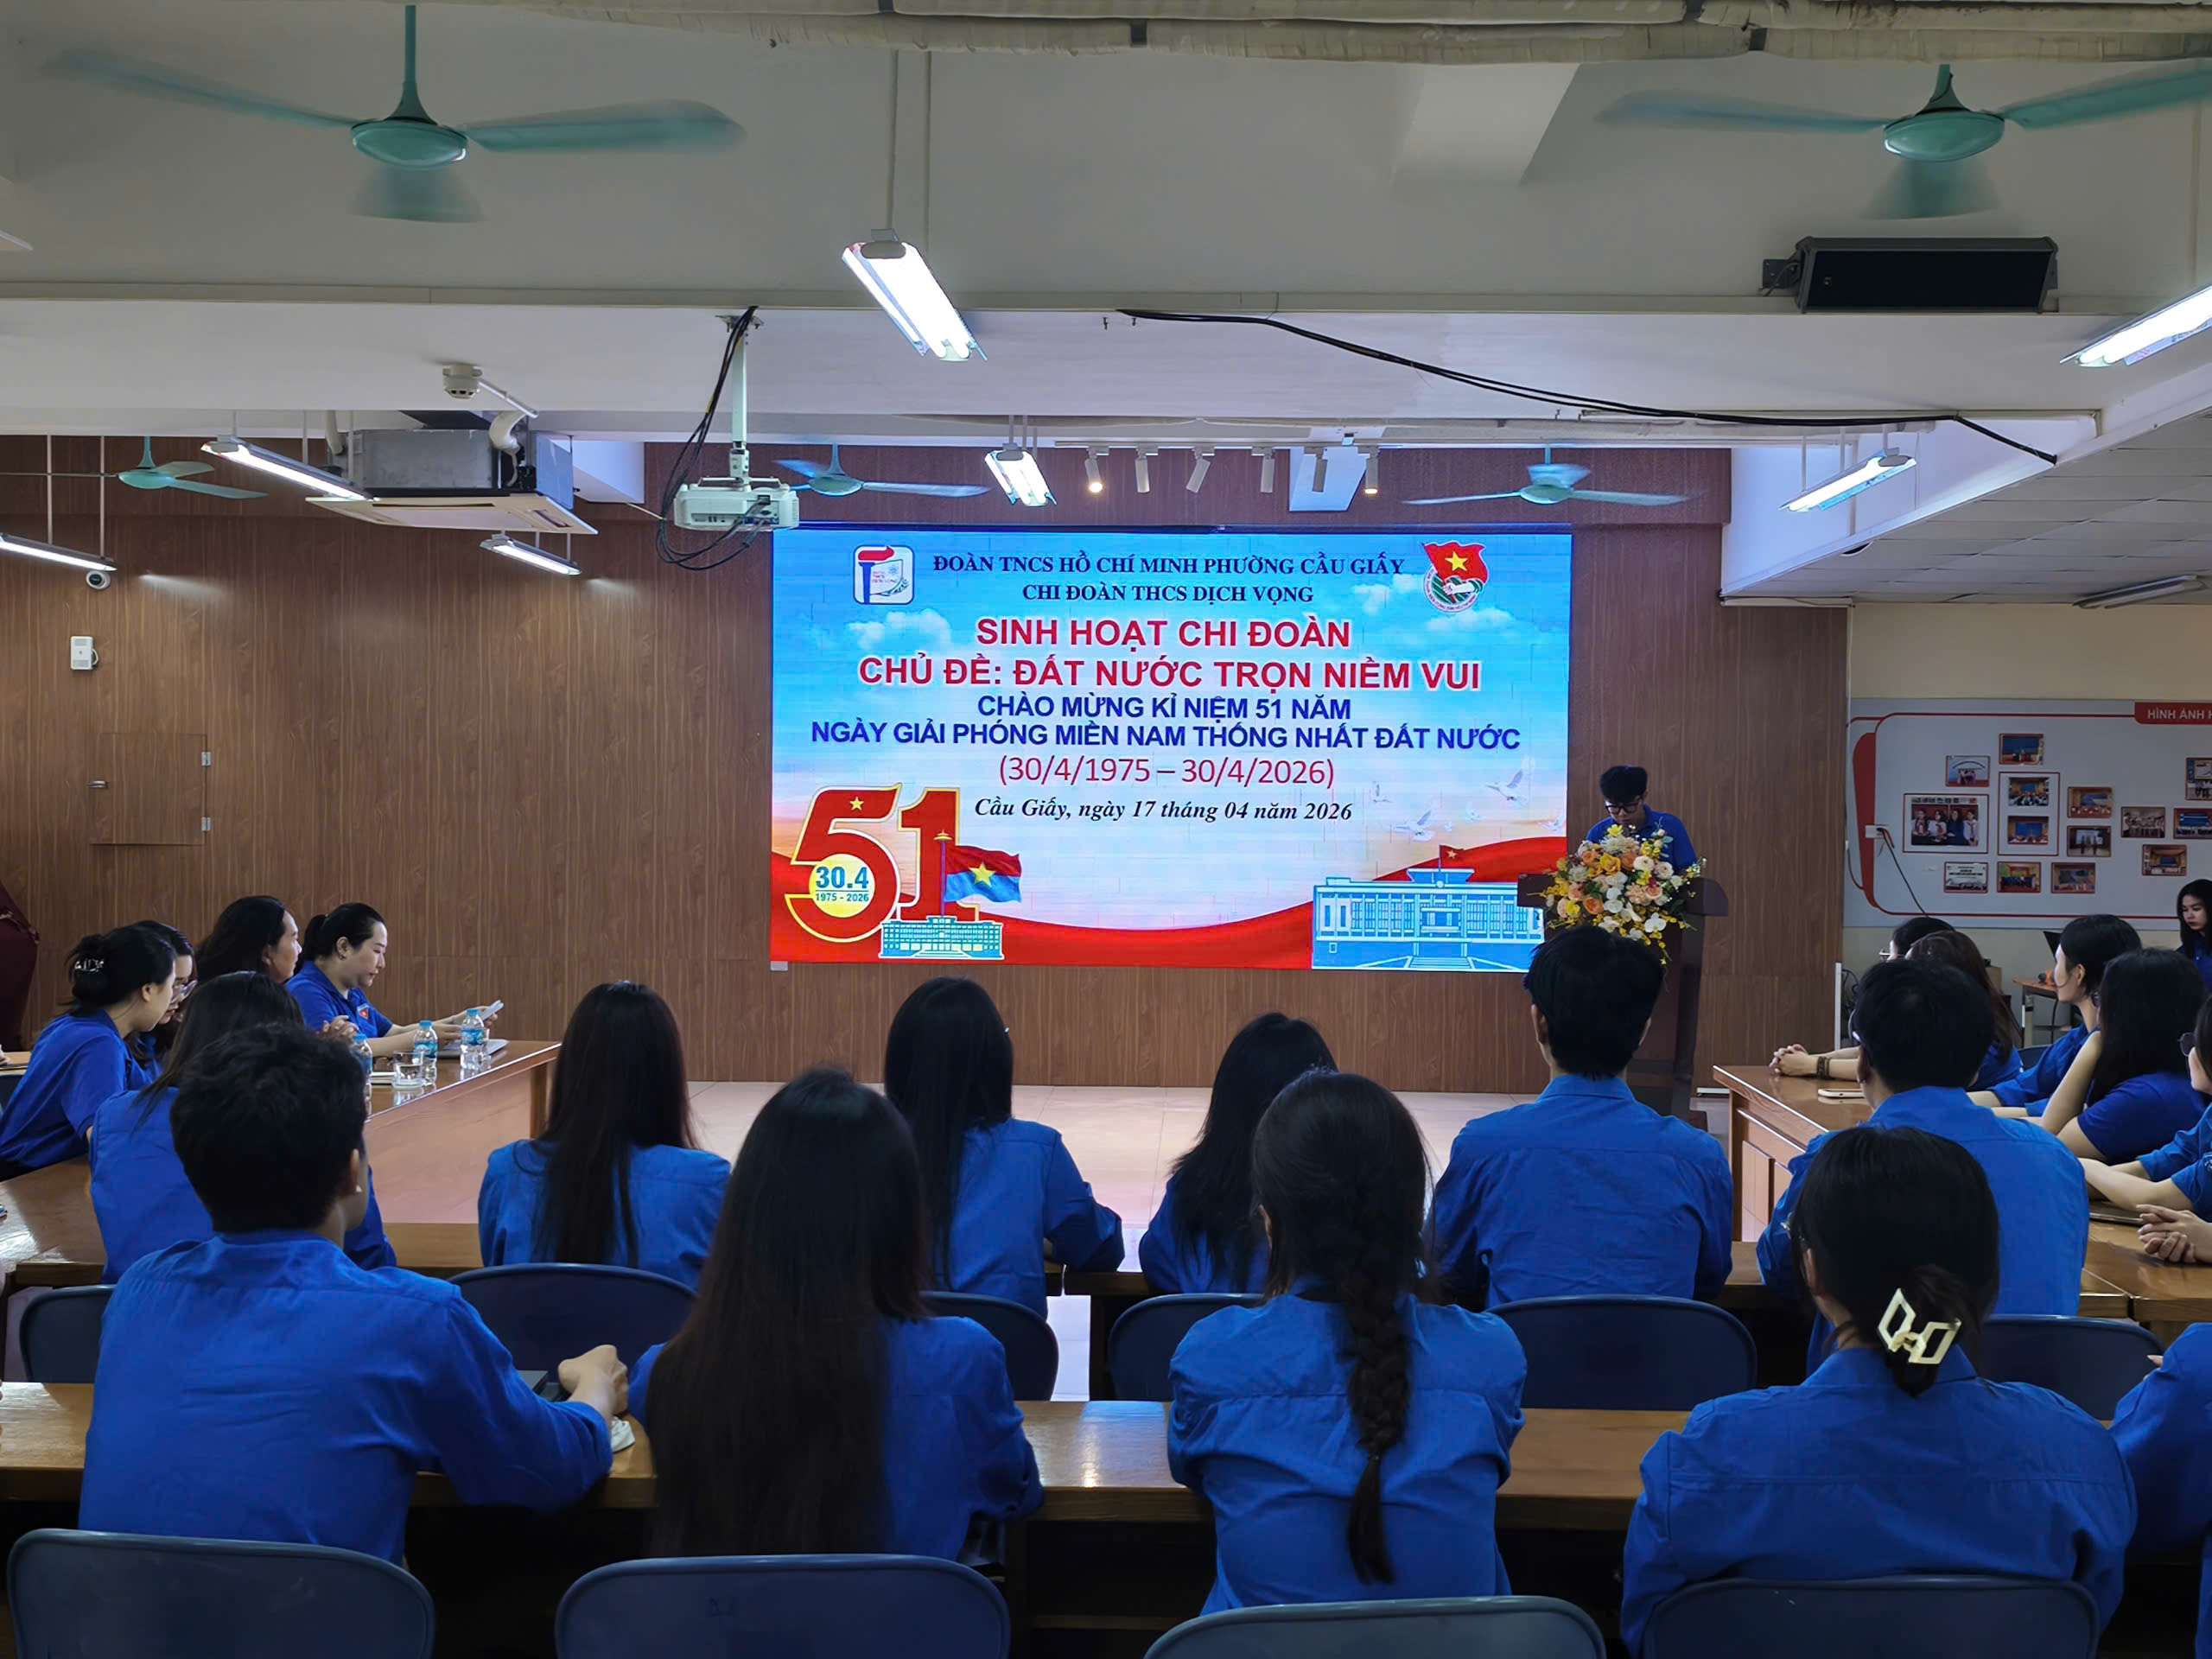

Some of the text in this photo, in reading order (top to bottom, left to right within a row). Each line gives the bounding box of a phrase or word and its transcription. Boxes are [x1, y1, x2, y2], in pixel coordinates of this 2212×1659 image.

[933, 550, 1405, 574] ĐOÀN TNCS HỒ CHÍ MINH PHƯỜNG CẦU GIẤY
[1023, 580, 1313, 606] CHI ĐOÀN THCS DỊCH VỌNG
[976, 614, 1351, 652] SINH HOẠT CHI ĐOÀN
[859, 652, 1480, 694] CHỦ ĐỀ: ĐẤT NƯỚC TRỌN NIỀM VUI
[977, 690, 1351, 723] CHÀO MỪNG KỈ NIỆM 51 NĂM
[2147, 707, 2177, 720] HÌNH
[811, 716, 1521, 749] NGÀY GIẢI PHÓNG MIỀN NAM THỐNG NHẤT ĐẤT NƯỚC
[999, 755, 1150, 786] (30/4/1975
[1181, 757, 1335, 788] 30/4/2026)
[976, 796, 1352, 823] Cầu Giấy, ngày 17 tháng 04 năm 2026
[785, 783, 979, 943] 51
[816, 866, 869, 889] 30.4
[816, 893, 837, 902] 1975
[847, 893, 869, 902] 2026
